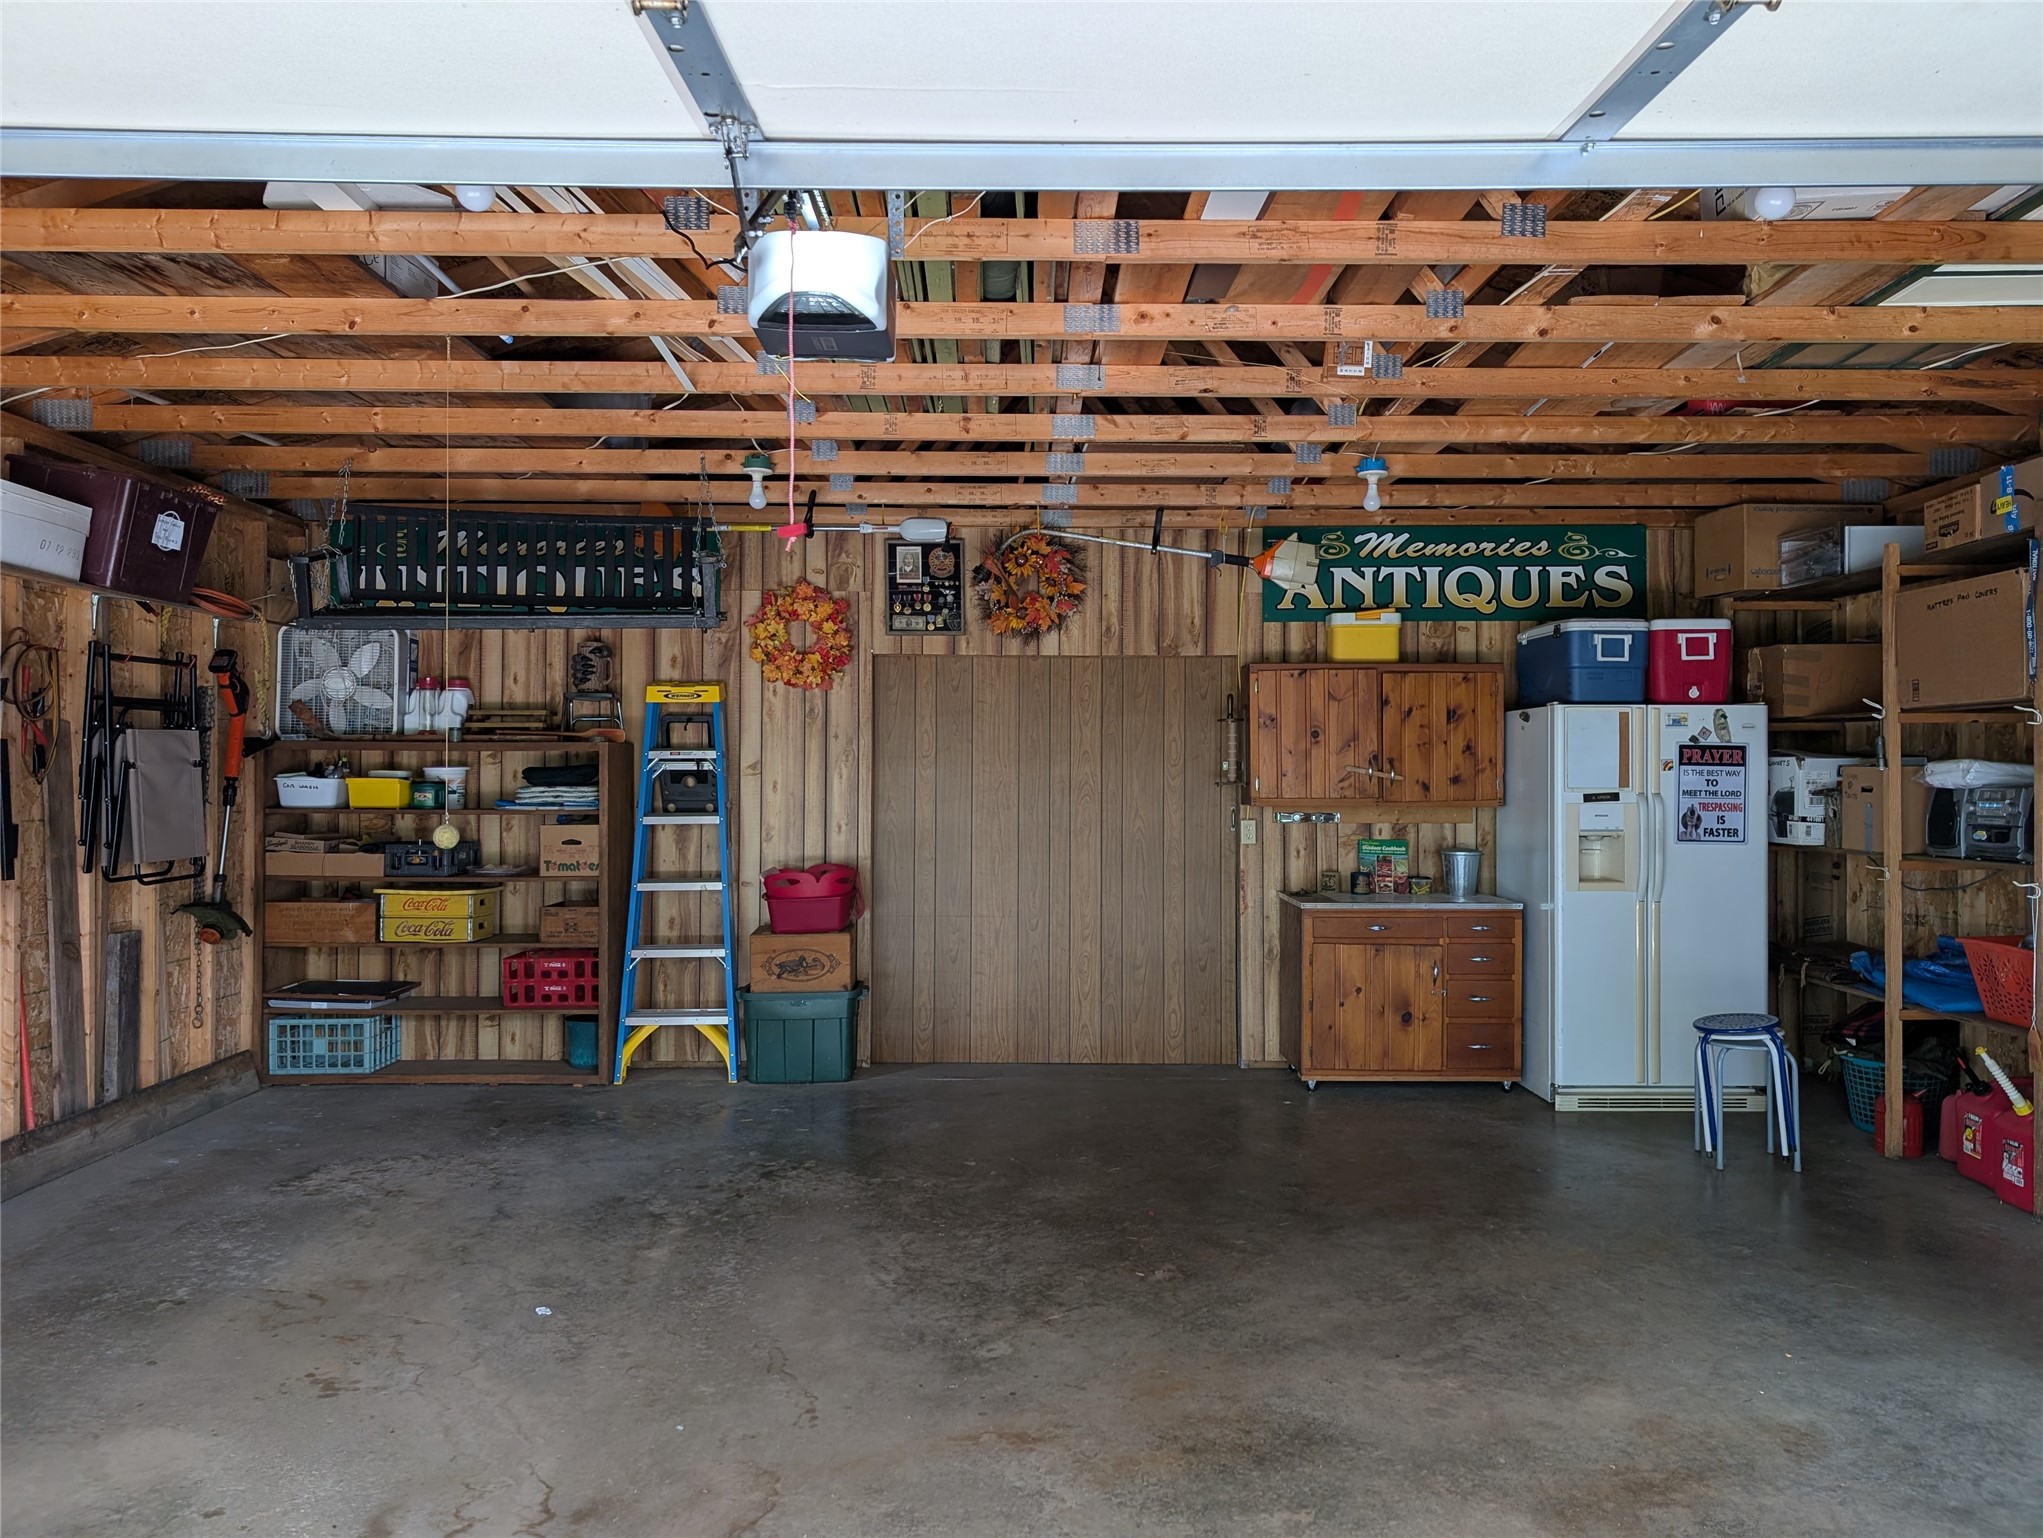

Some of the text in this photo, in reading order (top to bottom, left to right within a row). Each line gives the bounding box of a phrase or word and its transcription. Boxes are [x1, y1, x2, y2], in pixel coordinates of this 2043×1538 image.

[1353, 532, 1552, 559] Memories
[1277, 565, 1634, 614] ANTIQUES
[1957, 593, 1970, 603] PAD
[1975, 587, 1999, 598] COVERS
[1682, 748, 1744, 764] PRAYER
[1683, 769, 1690, 777] IS
[1691, 769, 1705, 777] THE
[1706, 769, 1724, 777] BEST
[1705, 779, 1719, 787] TO
[1681, 789, 1703, 797] MEET
[1704, 789, 1719, 797] THE
[1698, 802, 1743, 812] TRESPASSING
[1716, 815, 1726, 825] IS
[1703, 828, 1739, 838] FASTER
[402, 897, 448, 911] Coca-Cola
[394, 920, 455, 938] Coca-Cola
